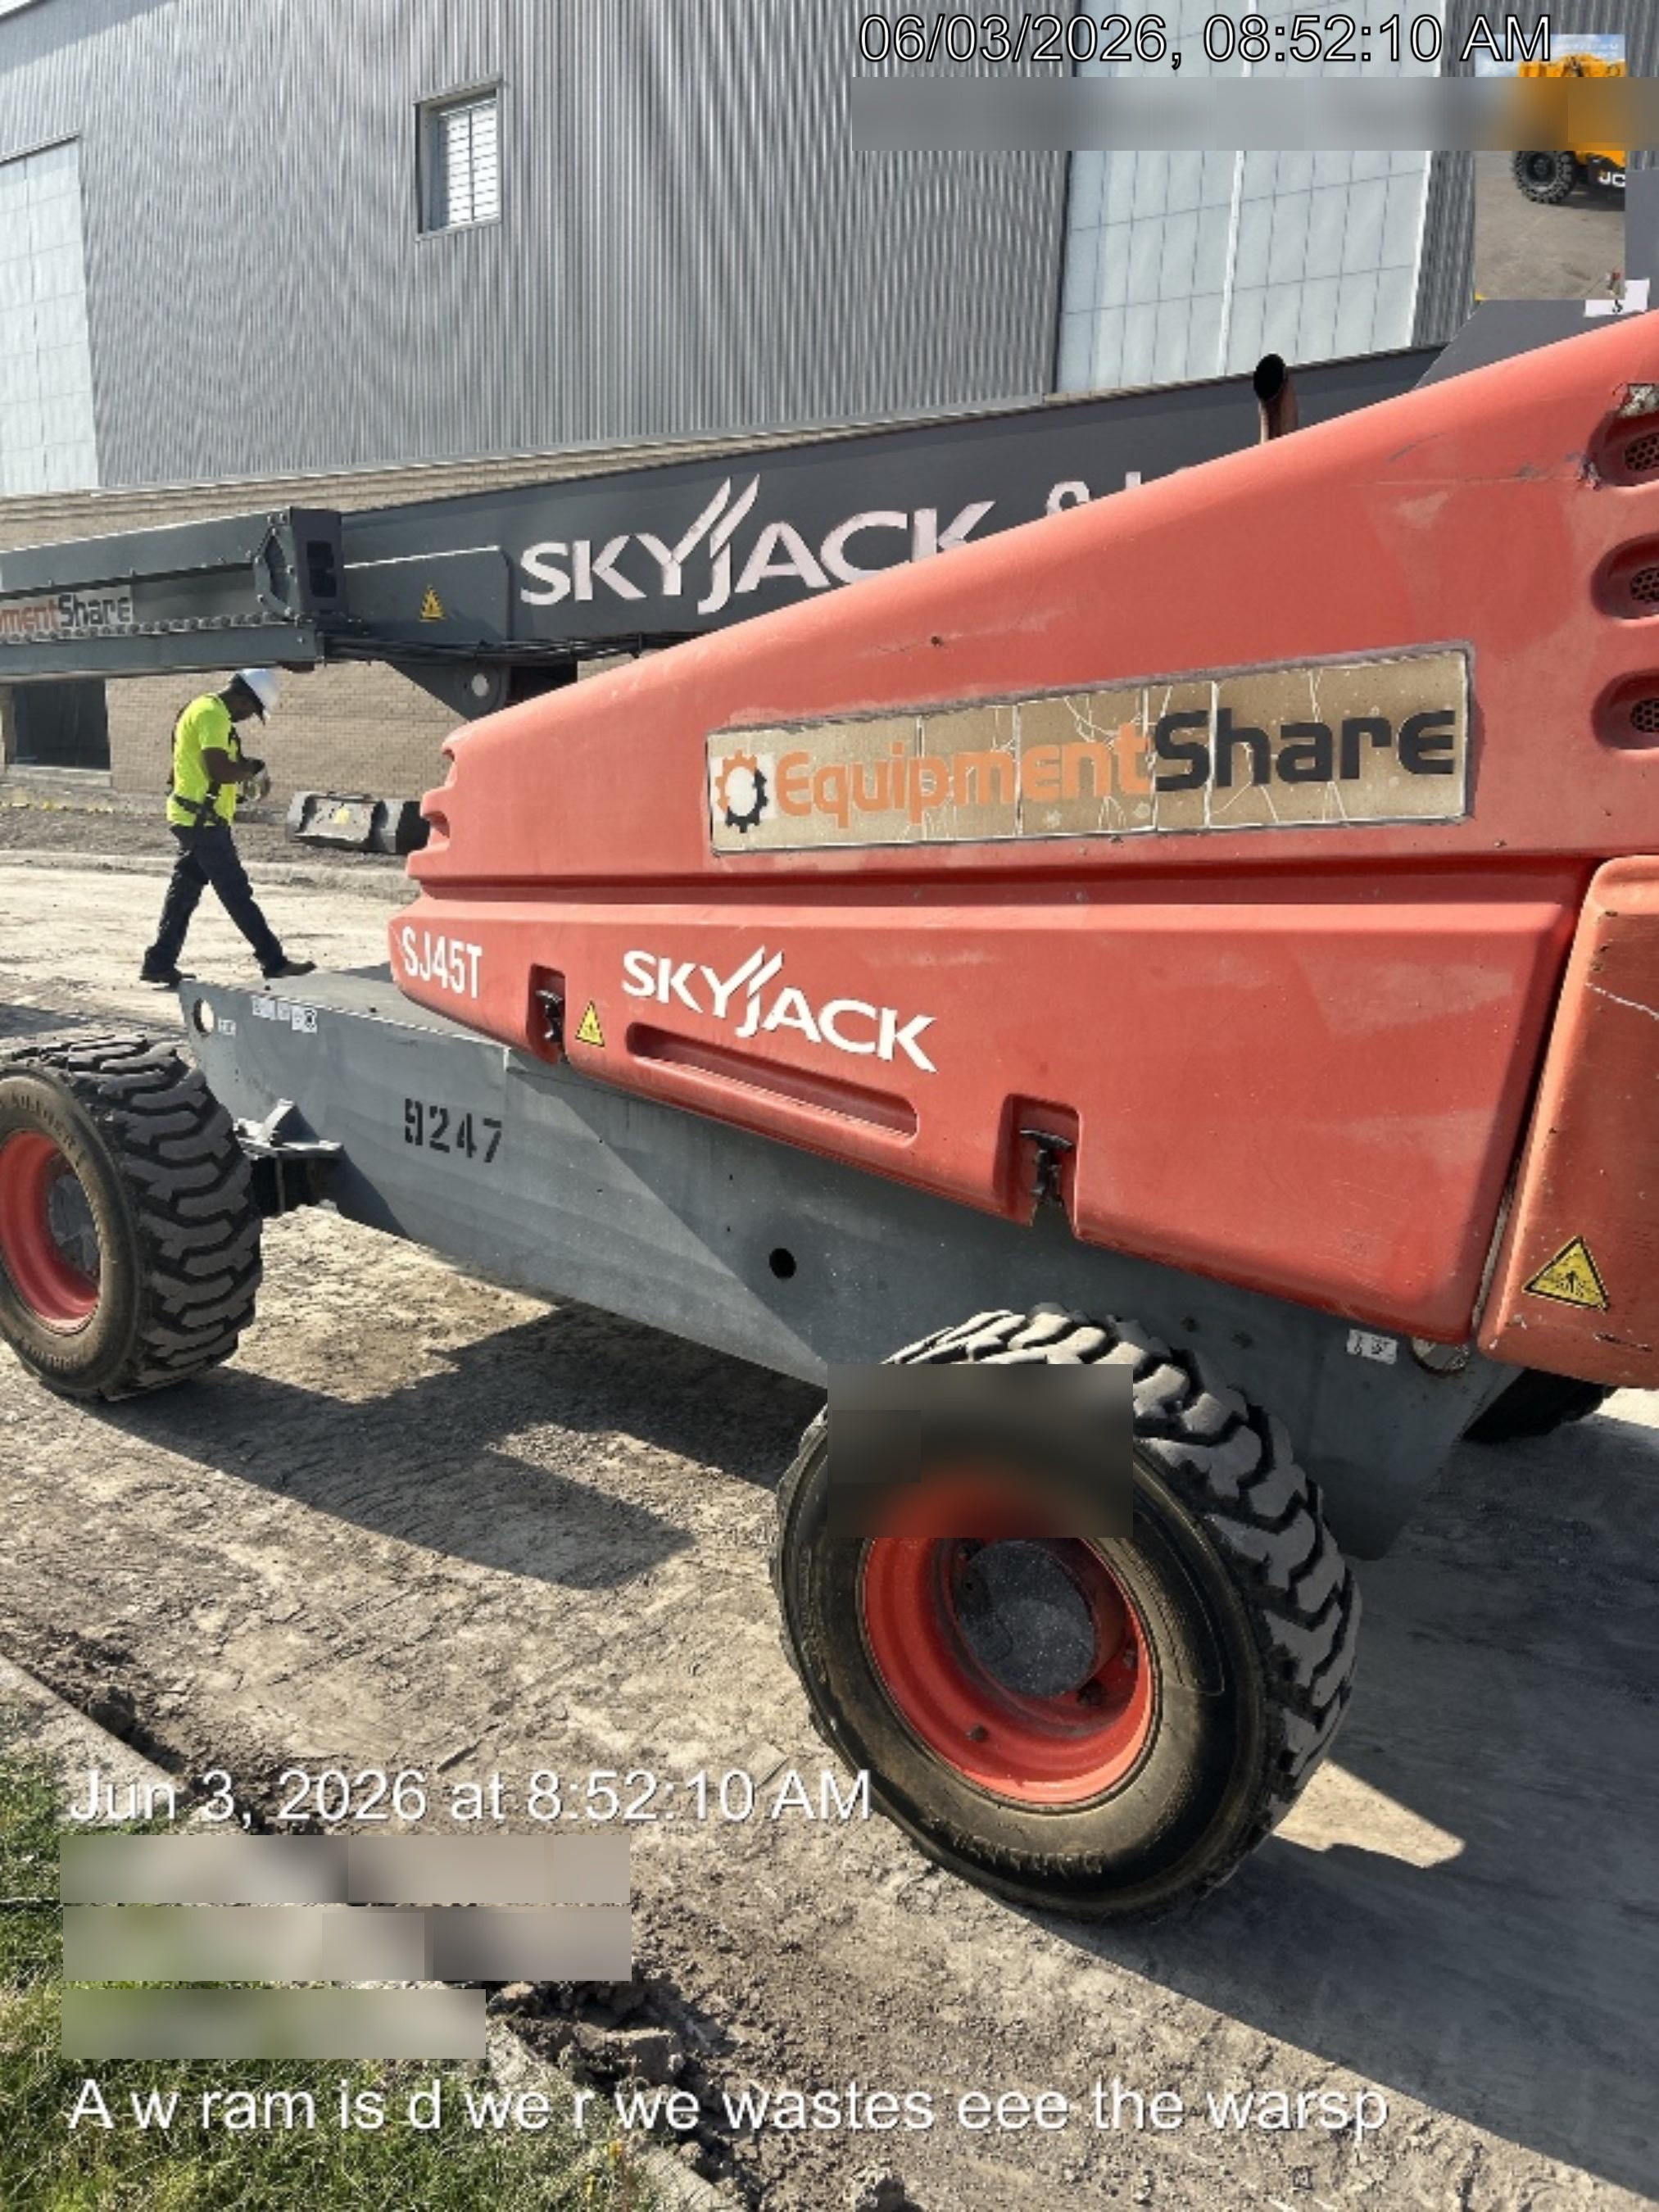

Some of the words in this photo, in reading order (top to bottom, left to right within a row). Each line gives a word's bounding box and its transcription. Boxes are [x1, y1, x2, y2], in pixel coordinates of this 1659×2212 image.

[519, 474, 996, 614] SKYJACK
[774, 709, 1457, 829] EquipmentShare
[401, 926, 483, 999] SJ45T
[622, 944, 938, 1073] SKYJACK
[404, 1098, 502, 1163] 9247
